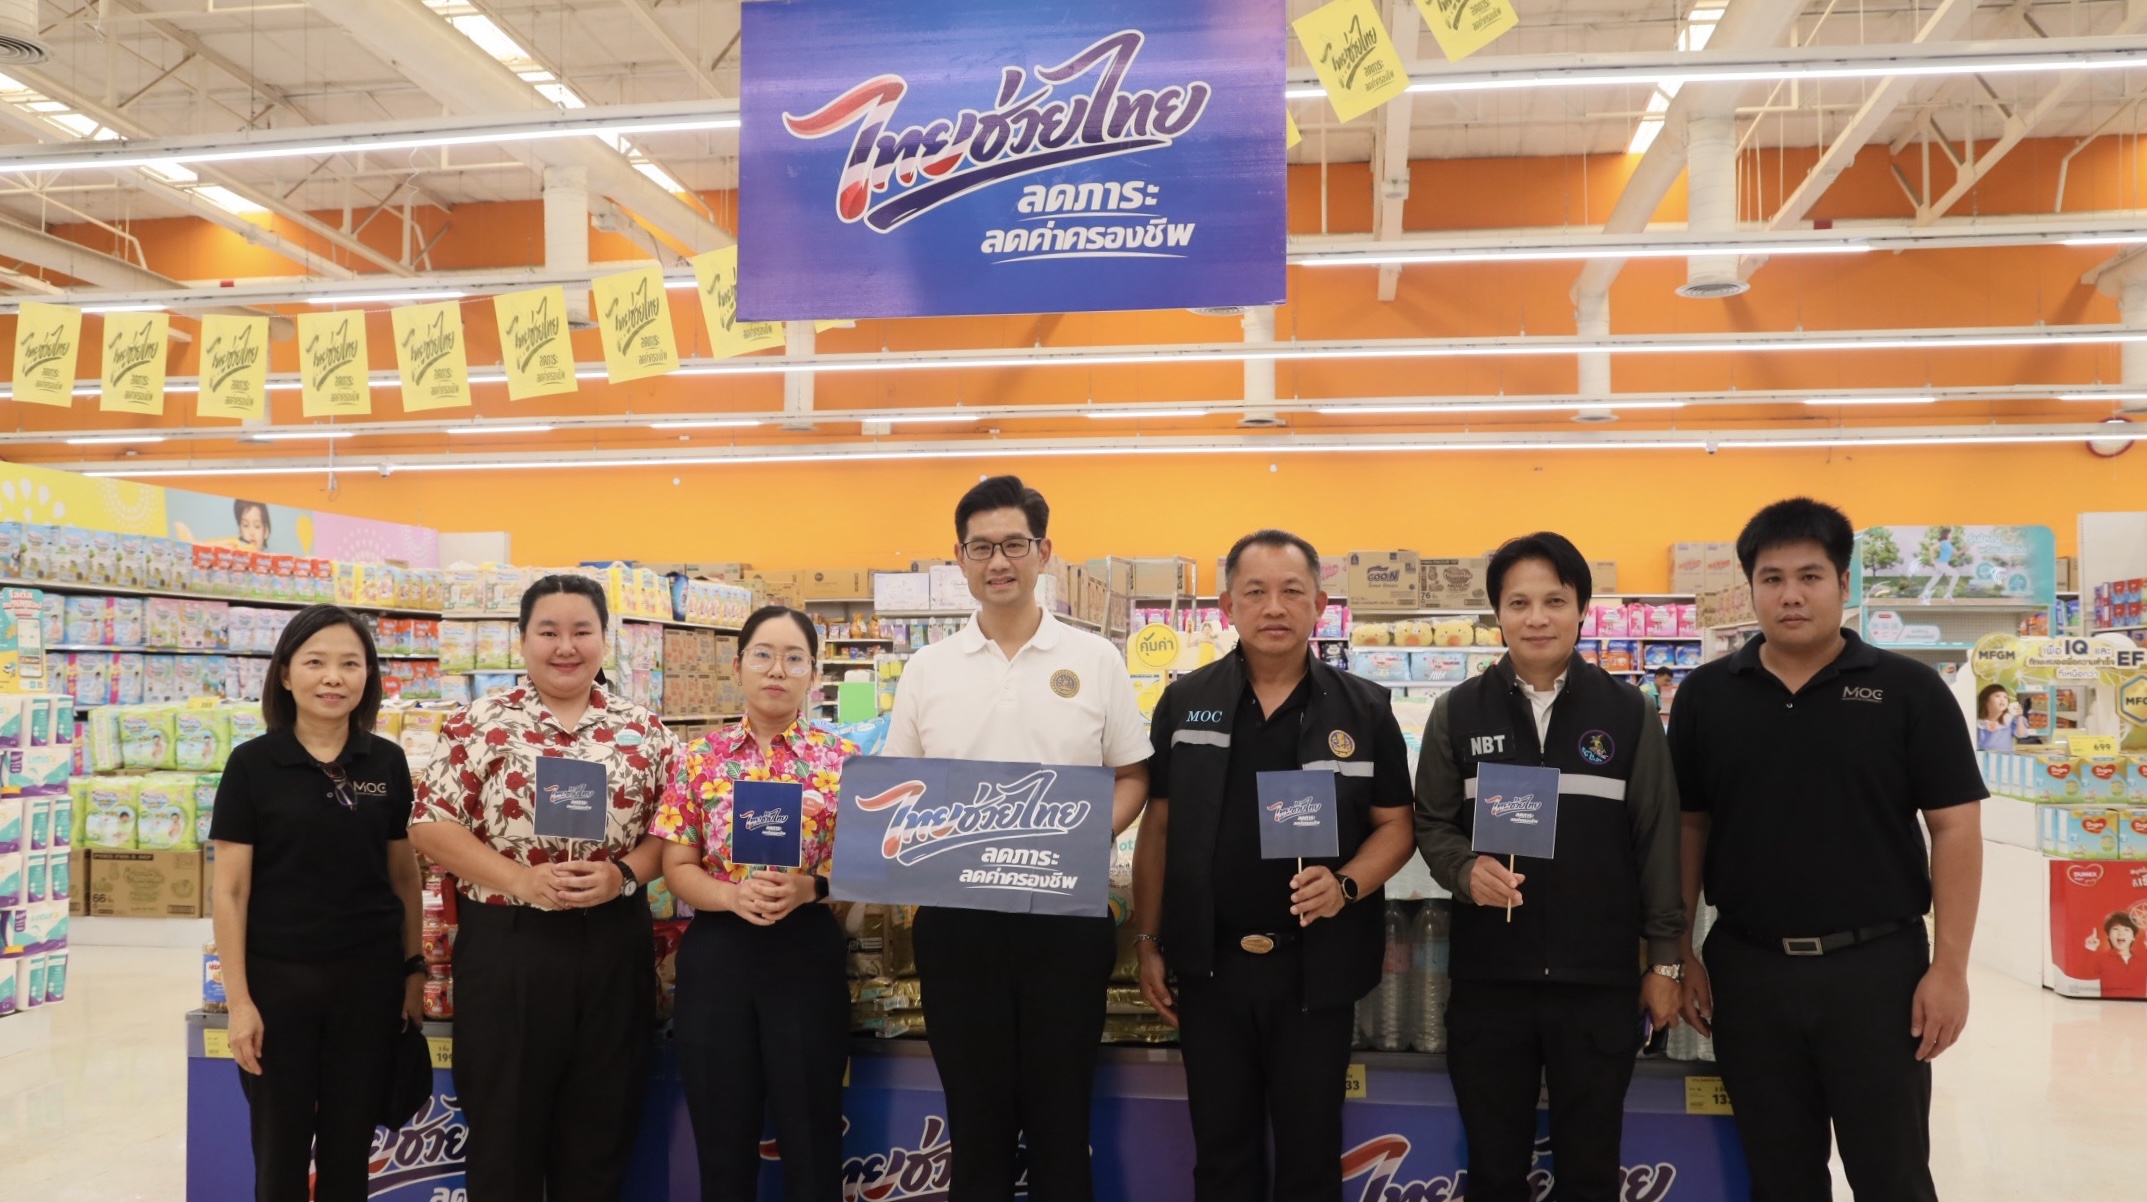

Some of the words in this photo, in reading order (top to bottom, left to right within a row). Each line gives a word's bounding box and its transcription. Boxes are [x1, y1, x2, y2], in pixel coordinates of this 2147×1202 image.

[782, 29, 1211, 223] ไทยช่วยไทย
[1017, 179, 1160, 214] ลดภาระ
[980, 218, 1196, 254] ลดค่าครองชีพ
[1420, 591, 1431, 599] 76
[1140, 633, 1174, 656] คุ้มค่า
[1978, 650, 2016, 660] MFGM
[2065, 639, 2089, 655] IQ
[2117, 651, 2145, 666] EF
[1842, 686, 1884, 700] MOC
[1186, 710, 1223, 723] MOC
[1470, 734, 1506, 756] NBT
[353, 781, 387, 794] MOC
[855, 769, 1091, 859] ไทยช่วยไทย
[981, 847, 1060, 867] ลดภาระ
[959, 868, 1079, 890] ลดค่าครองชีพ
[1712, 1094, 1731, 1105] 13
